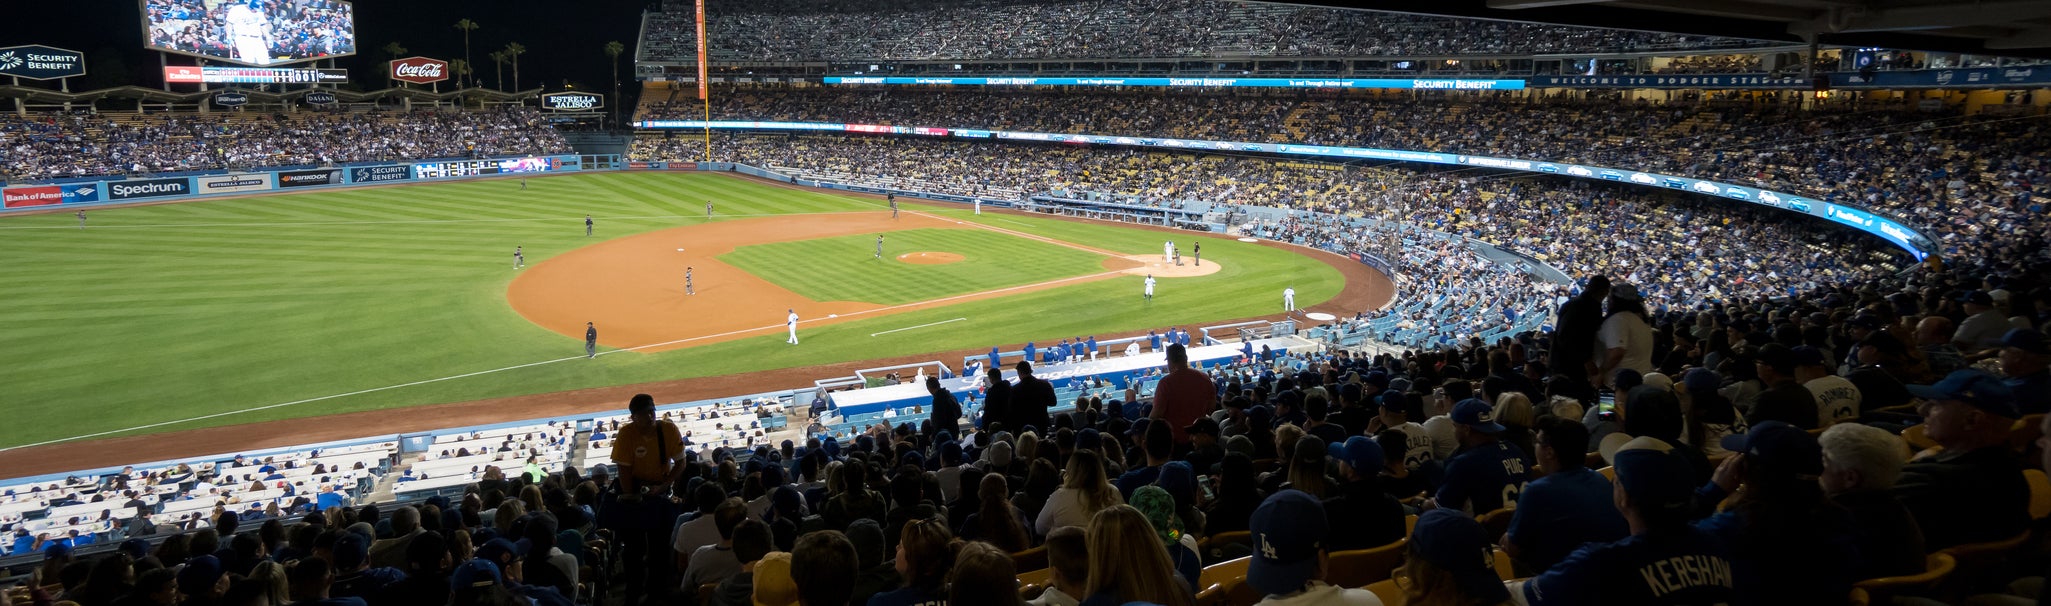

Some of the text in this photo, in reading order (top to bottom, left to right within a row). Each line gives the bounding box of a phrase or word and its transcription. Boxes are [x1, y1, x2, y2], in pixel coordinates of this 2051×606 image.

[27, 53, 77, 62] SECURITY
[28, 62, 72, 70] BENEFIT
[396, 63, 443, 77] Coca-Cola
[1170, 78, 1233, 86] SECURITY BENEFIT
[1413, 80, 1493, 89] SECURITY BENEFIT
[371, 166, 406, 174] SECURITY
[113, 182, 181, 197] Spectrum
[6, 191, 76, 201] Bank of America
[1819, 388, 1855, 406] RAMIREZ
[1502, 458, 1525, 476] PUIG
[1260, 533, 1279, 559] LA
[1640, 554, 1733, 597] KERSHAW
